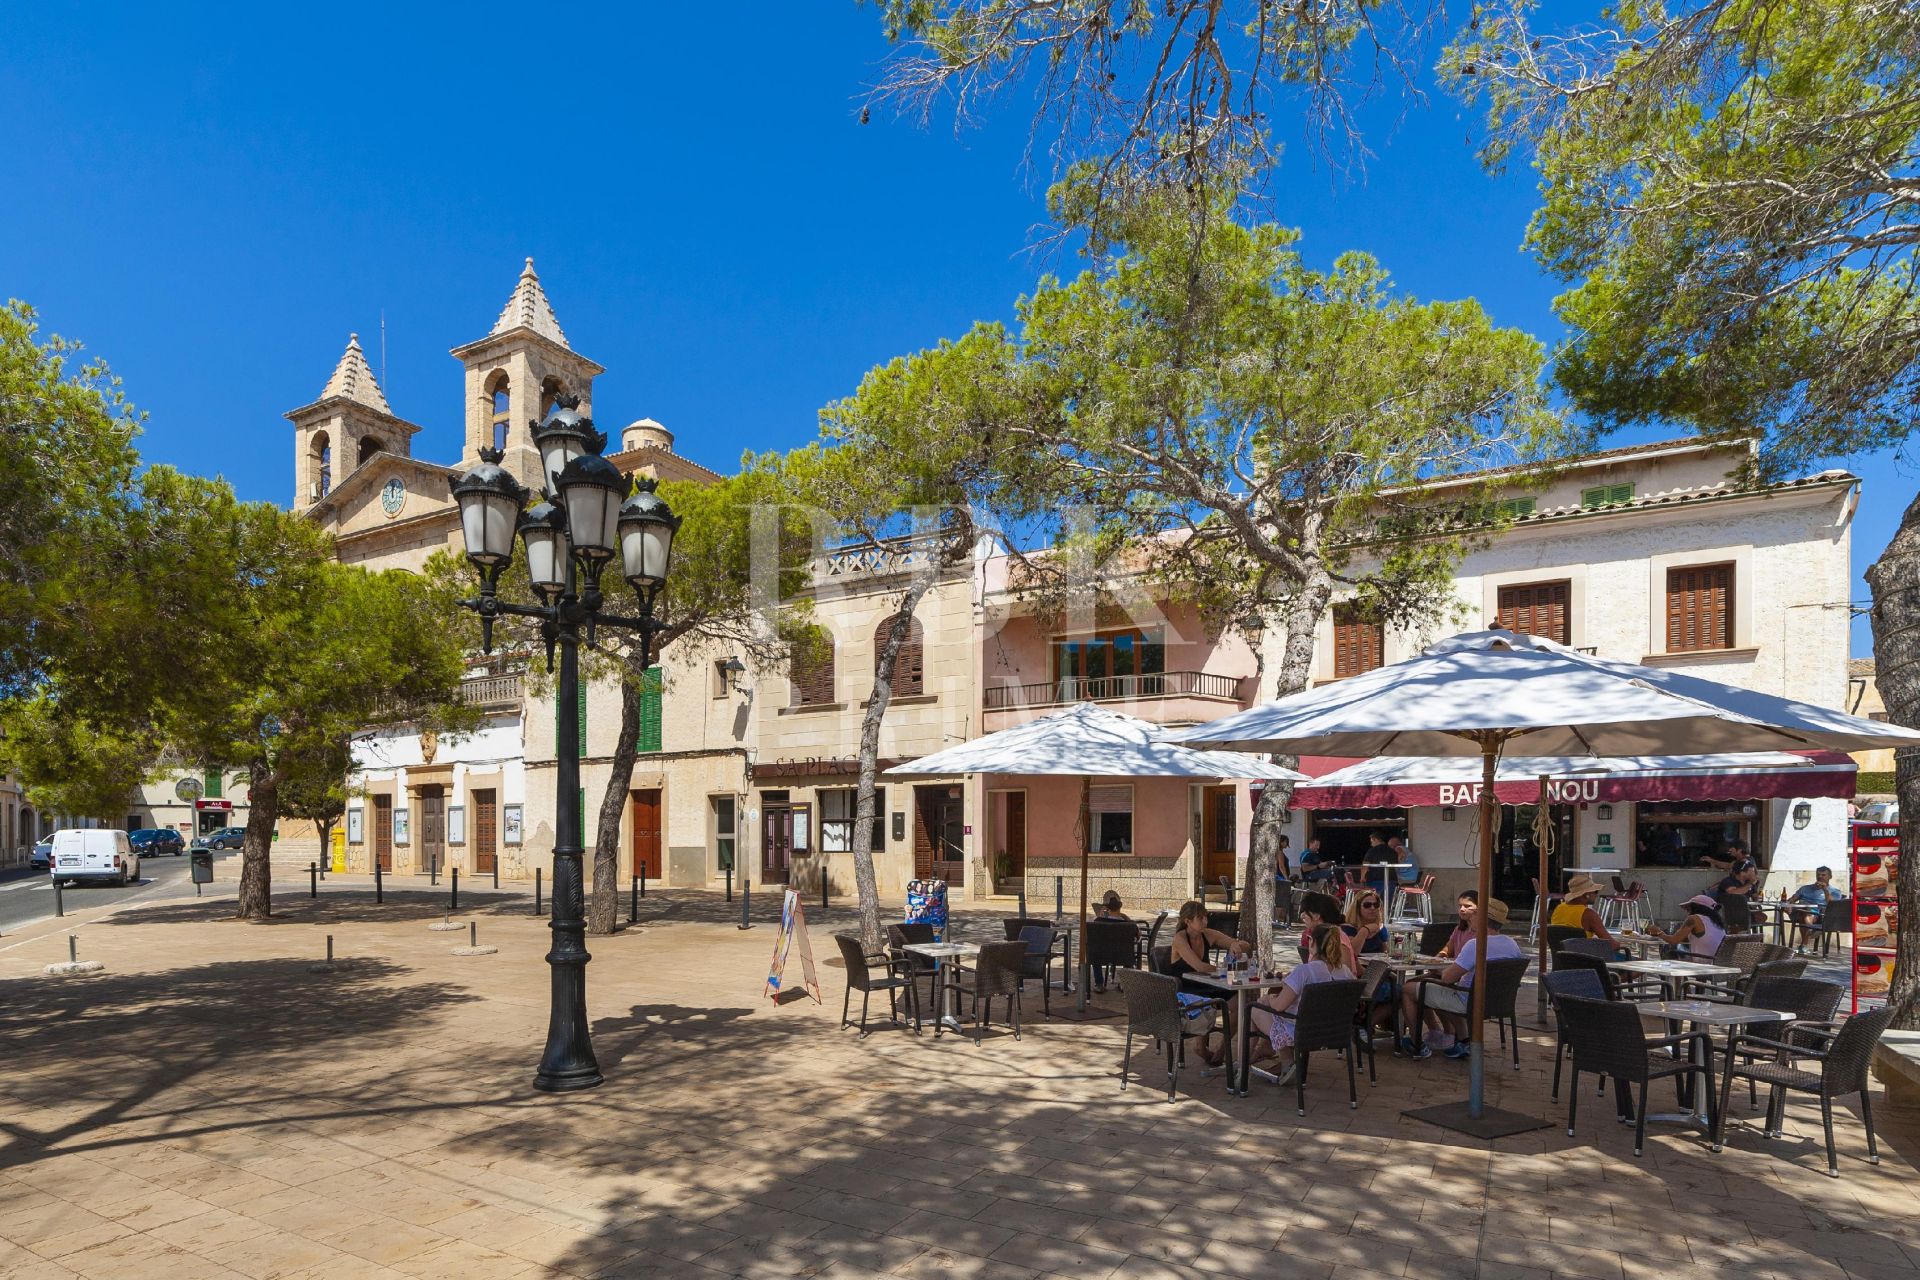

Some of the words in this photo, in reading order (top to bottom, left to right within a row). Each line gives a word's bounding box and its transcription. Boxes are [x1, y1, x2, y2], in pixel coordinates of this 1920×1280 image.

[776, 756, 799, 776] SA
[1546, 780, 1599, 801] NOU
[1871, 828, 1883, 837] BAR
[1883, 828, 1897, 837] NOU
